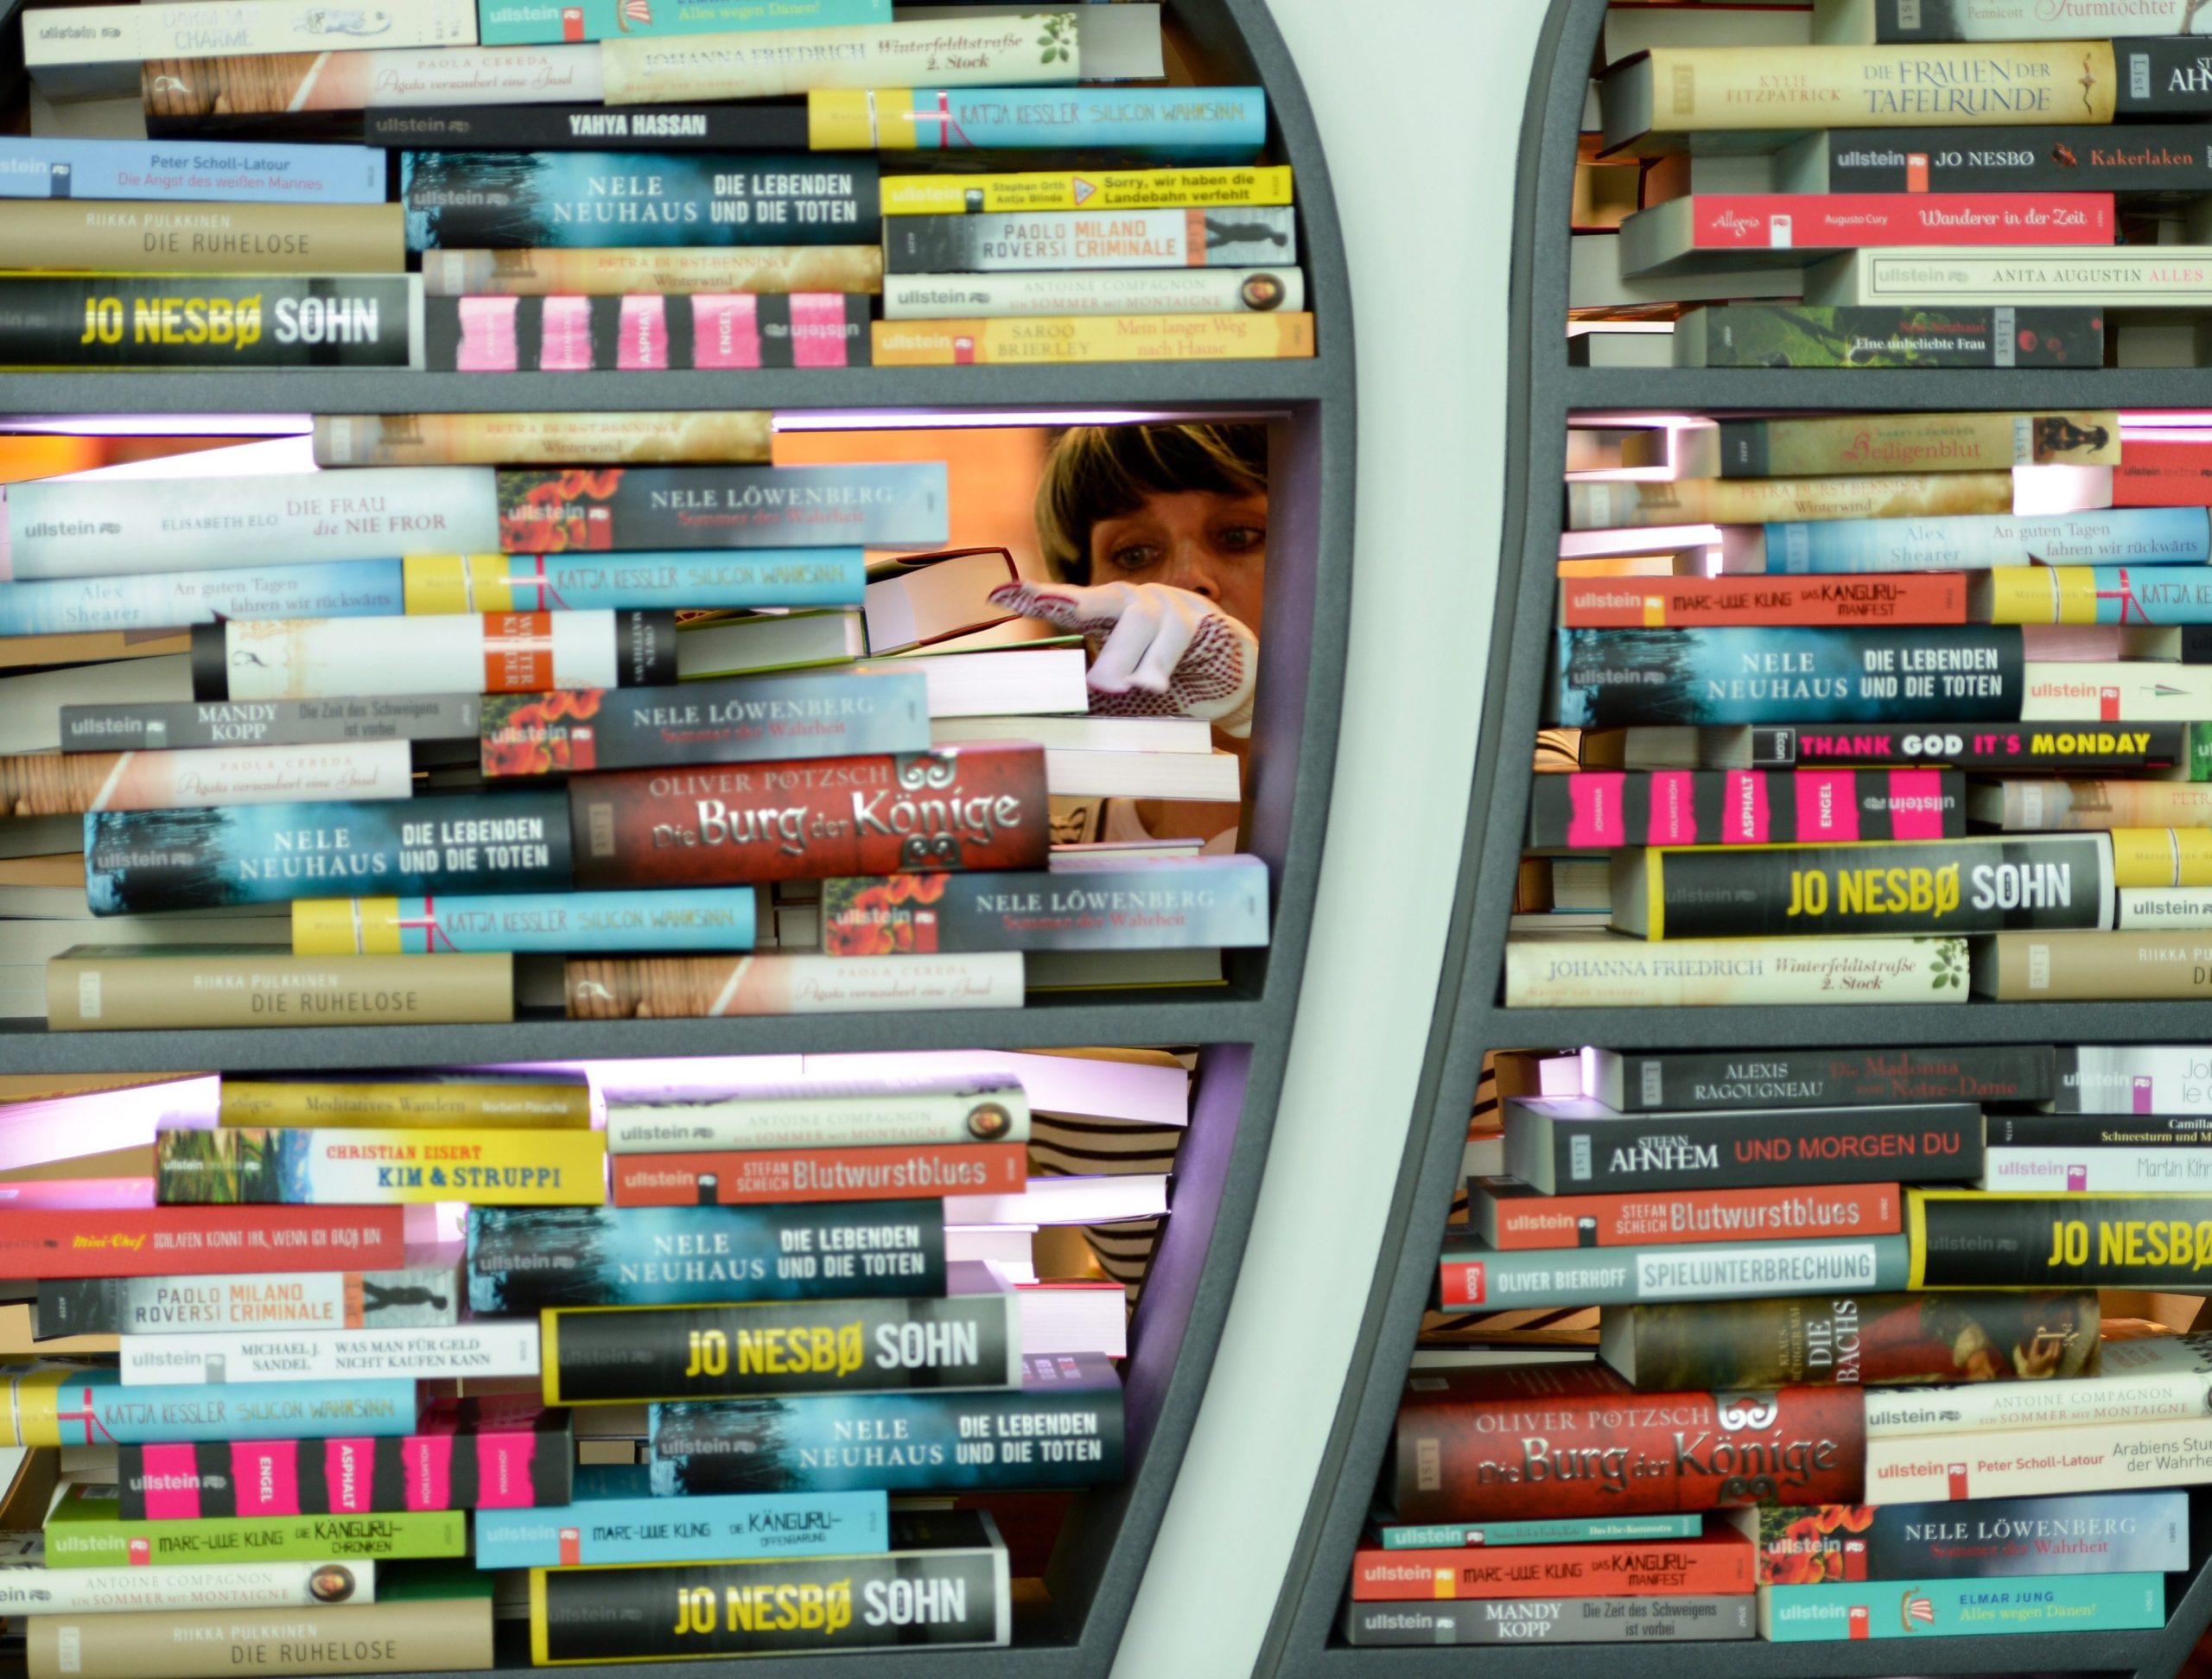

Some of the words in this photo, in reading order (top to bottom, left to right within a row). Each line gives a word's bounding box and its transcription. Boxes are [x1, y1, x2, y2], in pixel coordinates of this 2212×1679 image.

[489, 8, 559, 22] ullstein
[1864, 62, 1894, 80] DIE
[1899, 59, 2012, 87] FRAUEN
[2016, 63, 2051, 79] DER
[1727, 89, 1841, 104] FITZPATRICK
[1863, 86, 2051, 116] TAFELRUNDE
[569, 114, 628, 137] YAHYA
[632, 114, 707, 137] HASSAN
[150, 156, 190, 169] Peter
[194, 156, 290, 171] Scholl-Latour
[2090, 149, 2193, 167] Kakerlaken
[118, 173, 139, 187] Die
[142, 174, 185, 190] Angst
[188, 175, 212, 188] des
[215, 175, 264, 189] weißen
[268, 176, 323, 190] Mannes
[588, 175, 663, 196] NELE
[714, 174, 747, 195] DIE
[752, 174, 852, 195] LEBENDEN
[1103, 175, 1149, 190] Sorry,
[1153, 175, 1175, 187] wir
[1179, 173, 1227, 186] haben
[1231, 172, 1255, 185] die
[1103, 189, 1187, 204] Landebahn
[1191, 188, 1249, 202] verfehlt
[552, 200, 698, 222] NEUHAUS
[710, 200, 749, 222] UND
[756, 200, 786, 222] DIE
[796, 200, 857, 222] TOTEN
[143, 232, 180, 253] DIE
[192, 232, 310, 255] RUHELOSE
[983, 241, 1066, 259] ROVERSI
[1075, 238, 1176, 258] CRIMINALE
[1993, 270, 2047, 283] ANITA
[2053, 269, 2143, 283] AUGUSTIN
[2149, 269, 2205, 283] ALLES
[897, 290, 965, 305] ullstein
[81, 296, 125, 345] JO
[134, 292, 264, 351] NESBØ
[274, 296, 379, 345] SOHN
[1012, 323, 1076, 339] SAROO
[720, 310, 732, 355] ENGEL
[1856, 336, 1885, 350] Eine
[1887, 336, 1952, 351] unbeliebte
[1955, 336, 1986, 350] Frau
[24, 521, 96, 537] ullstein
[314, 521, 339, 537] die
[345, 518, 381, 534] NIE
[389, 514, 447, 531] FROR
[1993, 525, 2015, 538] An
[2018, 524, 2063, 542] guten
[2065, 521, 2111, 537] Tagen
[1891, 548, 1961, 563] Shearer
[2045, 542, 2096, 556] fahren
[2098, 541, 2124, 555] wir
[2126, 538, 2198, 555] rückwärts
[172, 582, 196, 597] An
[201, 581, 245, 598] guten
[254, 577, 298, 595] Tagen
[2142, 584, 2191, 605] KATJA
[645, 625, 656, 666] OWEN
[198, 704, 276, 722] MANDY
[211, 723, 267, 741] KOPP
[492, 725, 569, 744] ullstein
[1801, 735, 1891, 755] THANK
[1901, 735, 1964, 755] GOD
[1973, 734, 2021, 754] IT'S
[2031, 733, 2151, 754] MONDAY
[1742, 776, 1754, 837] ASPHALT
[1821, 782, 1832, 829] ENGEL
[653, 824, 696, 848] Die
[696, 803, 807, 854] Burg
[810, 811, 849, 838] der
[850, 788, 1023, 844] Könige
[274, 828, 350, 852] NELE
[238, 852, 388, 881] NEUHAUS
[399, 850, 439, 874] UND
[446, 848, 477, 871] DIE
[486, 844, 550, 868] TOTEN
[976, 894, 1042, 914] NELE
[1052, 887, 1215, 913] LÖWENBERG
[1788, 870, 1827, 918] JO
[1838, 862, 1961, 919] NESBØ
[1971, 863, 2071, 912] SOHN
[1110, 913, 1185, 928] Wahrheit
[1548, 961, 1647, 982] JOHANNA
[1652, 960, 1764, 977] FRIEDRICH
[1694, 1082, 1823, 1100] RAGOUGNEAU
[1734, 1140, 1792, 1162] UND
[1798, 1134, 1916, 1160] MORGEN
[1923, 1132, 1961, 1155] DU
[1573, 1141, 1587, 1175] List
[377, 1167, 424, 1188] KIM
[429, 1167, 449, 1187] &
[453, 1166, 562, 1188] STRUPPI
[742, 1162, 789, 1178] STEFAN
[792, 1158, 987, 1191] Blutwurstblues
[737, 1178, 790, 1193] SCHEICH
[1621, 1205, 1667, 1218] STEFAN
[1616, 1218, 1668, 1234] SCHEICH
[780, 1230, 813, 1252] DIE
[819, 1225, 920, 1250] LEBENDEN
[1498, 1272, 1551, 1293] OLIVER
[1555, 1268, 1627, 1291] BIERHOFF
[1643, 1253, 1872, 1288] SPIELUNTERBRECHUNG
[156, 1288, 222, 1305] PAOLO
[229, 1283, 303, 1301] MILANO
[1466, 1268, 1479, 1301] Econ
[137, 1305, 222, 1324] ROVERSI
[230, 1301, 334, 1323] CRIMINALE
[334, 1343, 366, 1356] WAS
[370, 1342, 403, 1354] MAN
[408, 1338, 434, 1354] FÜR
[437, 1339, 480, 1353] GELD
[686, 1328, 729, 1377] JO
[738, 1321, 863, 1377] NESBØ
[875, 1321, 978, 1369] SOHN
[1808, 1320, 1832, 1367] DIE
[1834, 1299, 1860, 1383] BACHS
[252, 1357, 311, 1372] SANDEL
[335, 1357, 383, 1371] NICHT
[387, 1355, 446, 1370] KAUFEN
[449, 1352, 491, 1368] KANN
[1993, 1394, 2064, 1410] ANTOINE
[2070, 1387, 2174, 1403] COMPAGNON
[2113, 1440, 2178, 1457] Arabiens
[499, 1449, 508, 1495] JOHANNA
[1978, 1459, 2014, 1473] Peter
[2017, 1454, 2105, 1471] Scholl-Latour
[340, 1445, 353, 1509] ASPHALT
[159, 1534, 238, 1553] MARC-UWE
[244, 1530, 284, 1547] KLING
[593, 1526, 669, 1542] MARC-UWE
[673, 1523, 711, 1539] KLING
[1592, 1560, 1610, 1571] DAS
[1629, 1574, 1687, 1587] MANIFEST
[1960, 1592, 2010, 1606] ELMAR
[2016, 1590, 2055, 1603] JUNG
[1583, 1604, 1601, 1619] Die
[1605, 1602, 1625, 1619] Zeit
[1629, 1602, 1648, 1618] des
[1652, 1601, 1717, 1621] Schweigens
[1960, 1606, 1995, 1622] Alles
[1999, 1606, 2039, 1622] wegen
[2046, 1603, 2095, 1618] Dänen!
[174, 1626, 224, 1642] RIIKKA
[232, 1625, 318, 1640] PULKKINEN
[1624, 1624, 1640, 1638] ist
[1642, 1622, 1675, 1638] vorbei
[232, 1644, 266, 1664] DIE
[279, 1641, 397, 1663] RUHELOSE
